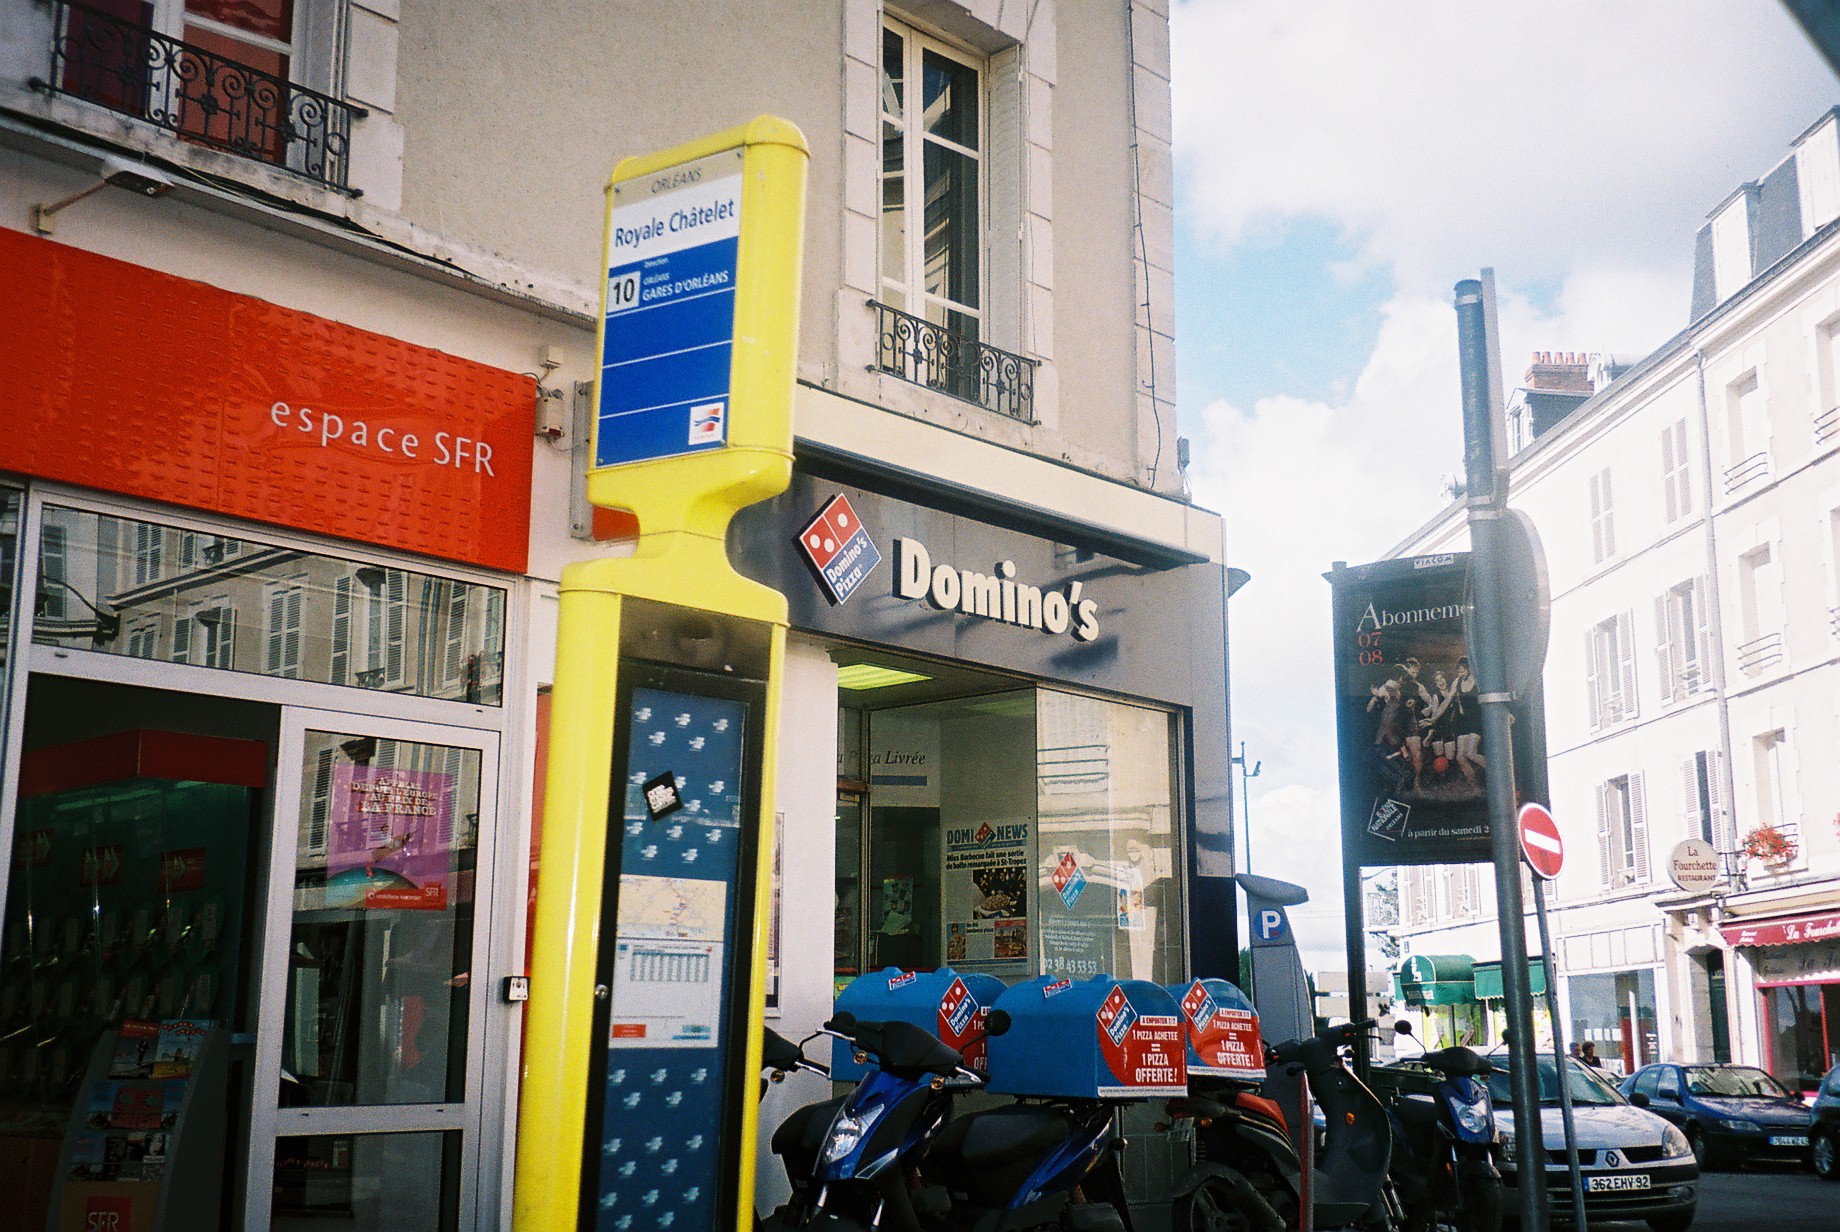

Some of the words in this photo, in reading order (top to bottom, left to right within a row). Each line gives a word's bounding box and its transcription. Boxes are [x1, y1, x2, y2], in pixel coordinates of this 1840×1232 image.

[651, 168, 702, 194] ORLÉANS
[614, 216, 665, 249] Royale
[669, 199, 735, 233] Châtelet
[613, 278, 635, 305] 10
[642, 282, 673, 301] GARES
[674, 270, 729, 294] D'ORLÉANS
[270, 401, 419, 458] espace
[433, 431, 495, 477] SFR
[826, 535, 868, 582] Domino's
[1415, 555, 1453, 566] VIACOM
[835, 568, 861, 599] Pizza
[898, 536, 1100, 642] Domino's
[1358, 631, 1382, 648] 07
[1360, 649, 1383, 667] 08
[884, 750, 926, 765] Livrée
[361, 801, 382, 813] LA
[385, 803, 437, 816] FRANCE
[946, 828, 975, 844] DOMI
[996, 823, 1029, 841] NEWS
[1407, 829, 1414, 838] à
[1414, 829, 1438, 840] partir
[1438, 827, 1450, 836] du
[1451, 825, 1482, 836] samedi
[1687, 845, 1699, 857] La
[1673, 859, 1717, 871] Fourchette
[1677, 874, 1716, 882] RESTAURANT
[1261, 910, 1281, 939] P
[1786, 924, 1800, 940] La
[1054, 956, 1065, 973] 38
[1066, 959, 1076, 974] 43
[1077, 960, 1087, 974] 53
[1087, 960, 1098, 974] 53
[950, 997, 971, 1027] Domino's
[1194, 999, 1212, 1025] Domino's
[955, 1013, 969, 1033] Pizza
[1109, 1006, 1130, 1037] Domino's
[1216, 1020, 1230, 1029] PIZZA
[1231, 1021, 1253, 1032] ACHETEE
[1114, 1023, 1128, 1044] Pizza
[1132, 1030, 1136, 1041] 1
[1136, 1031, 1153, 1041] PIZZA
[1153, 1031, 1178, 1041] ACHETEE
[1221, 1040, 1225, 1050] 1
[1225, 1041, 1246, 1053] PIZZA
[1142, 1053, 1147, 1066] 1
[1147, 1053, 1169, 1066] PIZZA
[1216, 1052, 1255, 1067] OFFERTE!
[1135, 1067, 1178, 1083] OFFERTE!
[1592, 1178, 1613, 1190] 362
[1613, 1177, 1634, 1189] EHV
[1635, 1175, 1649, 1188] 92
[88, 1211, 119, 1232] SFR
